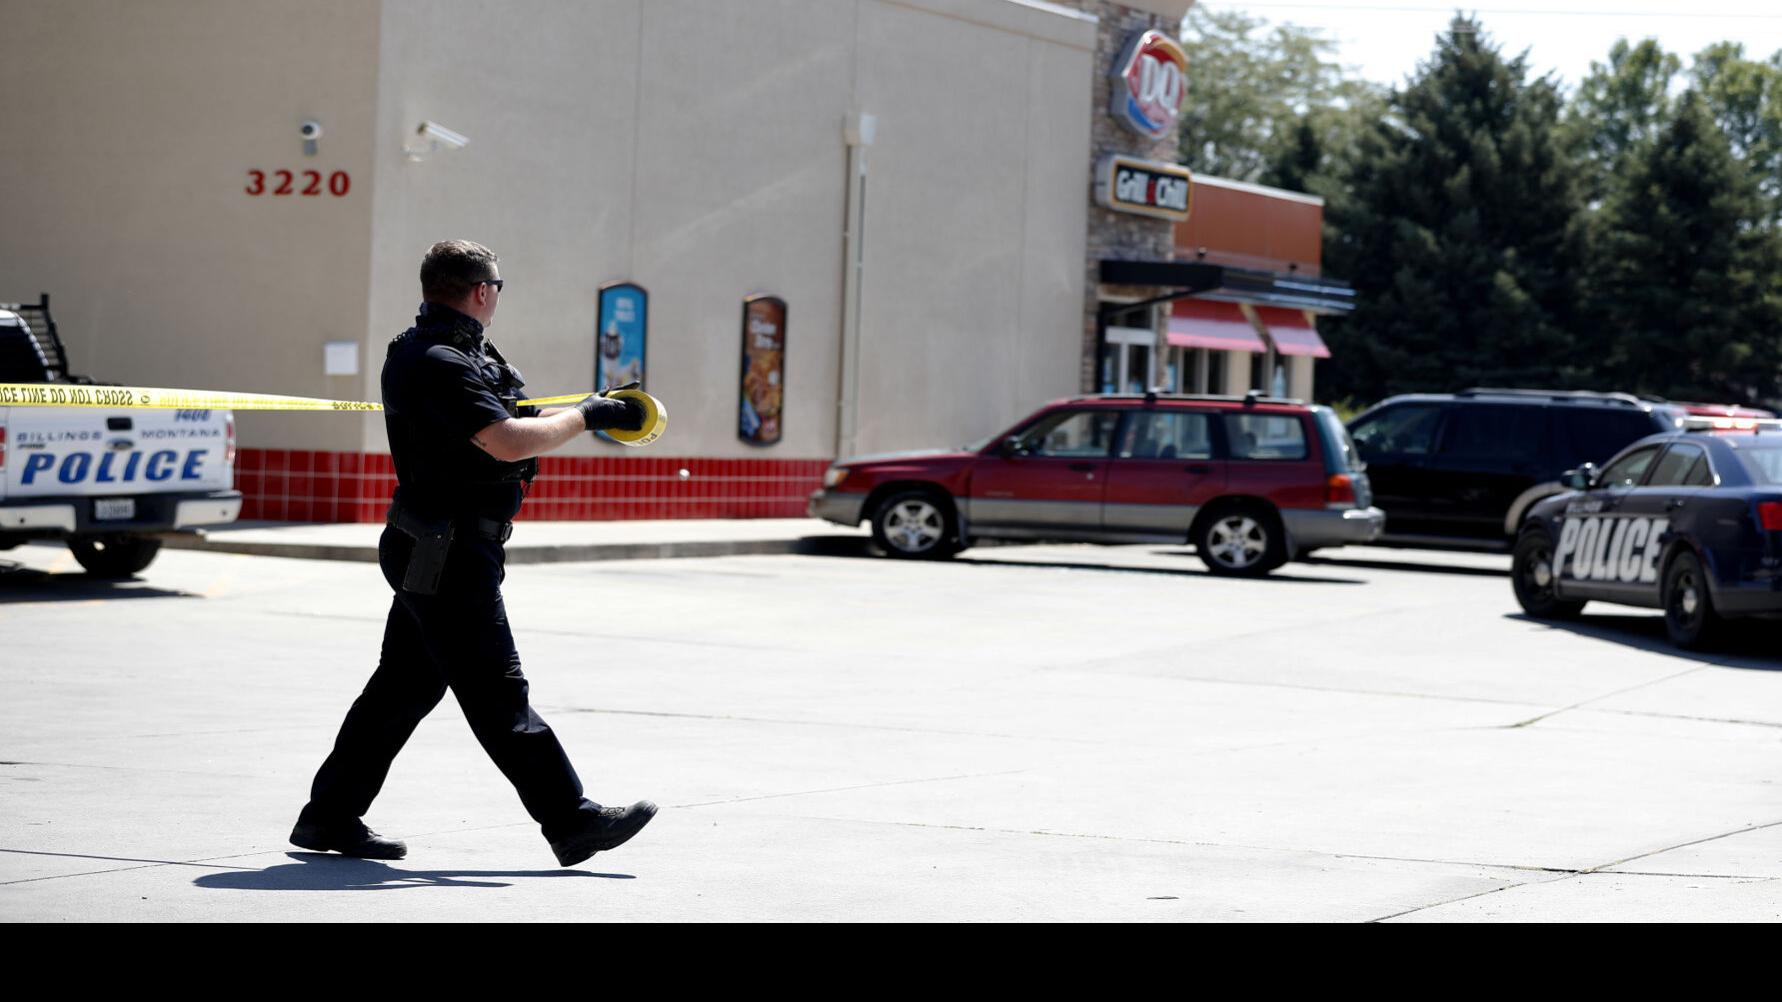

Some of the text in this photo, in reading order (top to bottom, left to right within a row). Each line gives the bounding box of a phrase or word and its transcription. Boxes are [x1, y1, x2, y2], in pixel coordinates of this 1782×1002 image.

[1138, 54, 1181, 115] DQ
[245, 169, 351, 197] 3220
[1117, 171, 1148, 203] Grill
[1156, 177, 1189, 209] Chill
[17, 429, 221, 442] BILLINGS MONTANA
[21, 450, 208, 485] POLICE
[1552, 517, 1670, 582] POLICE
